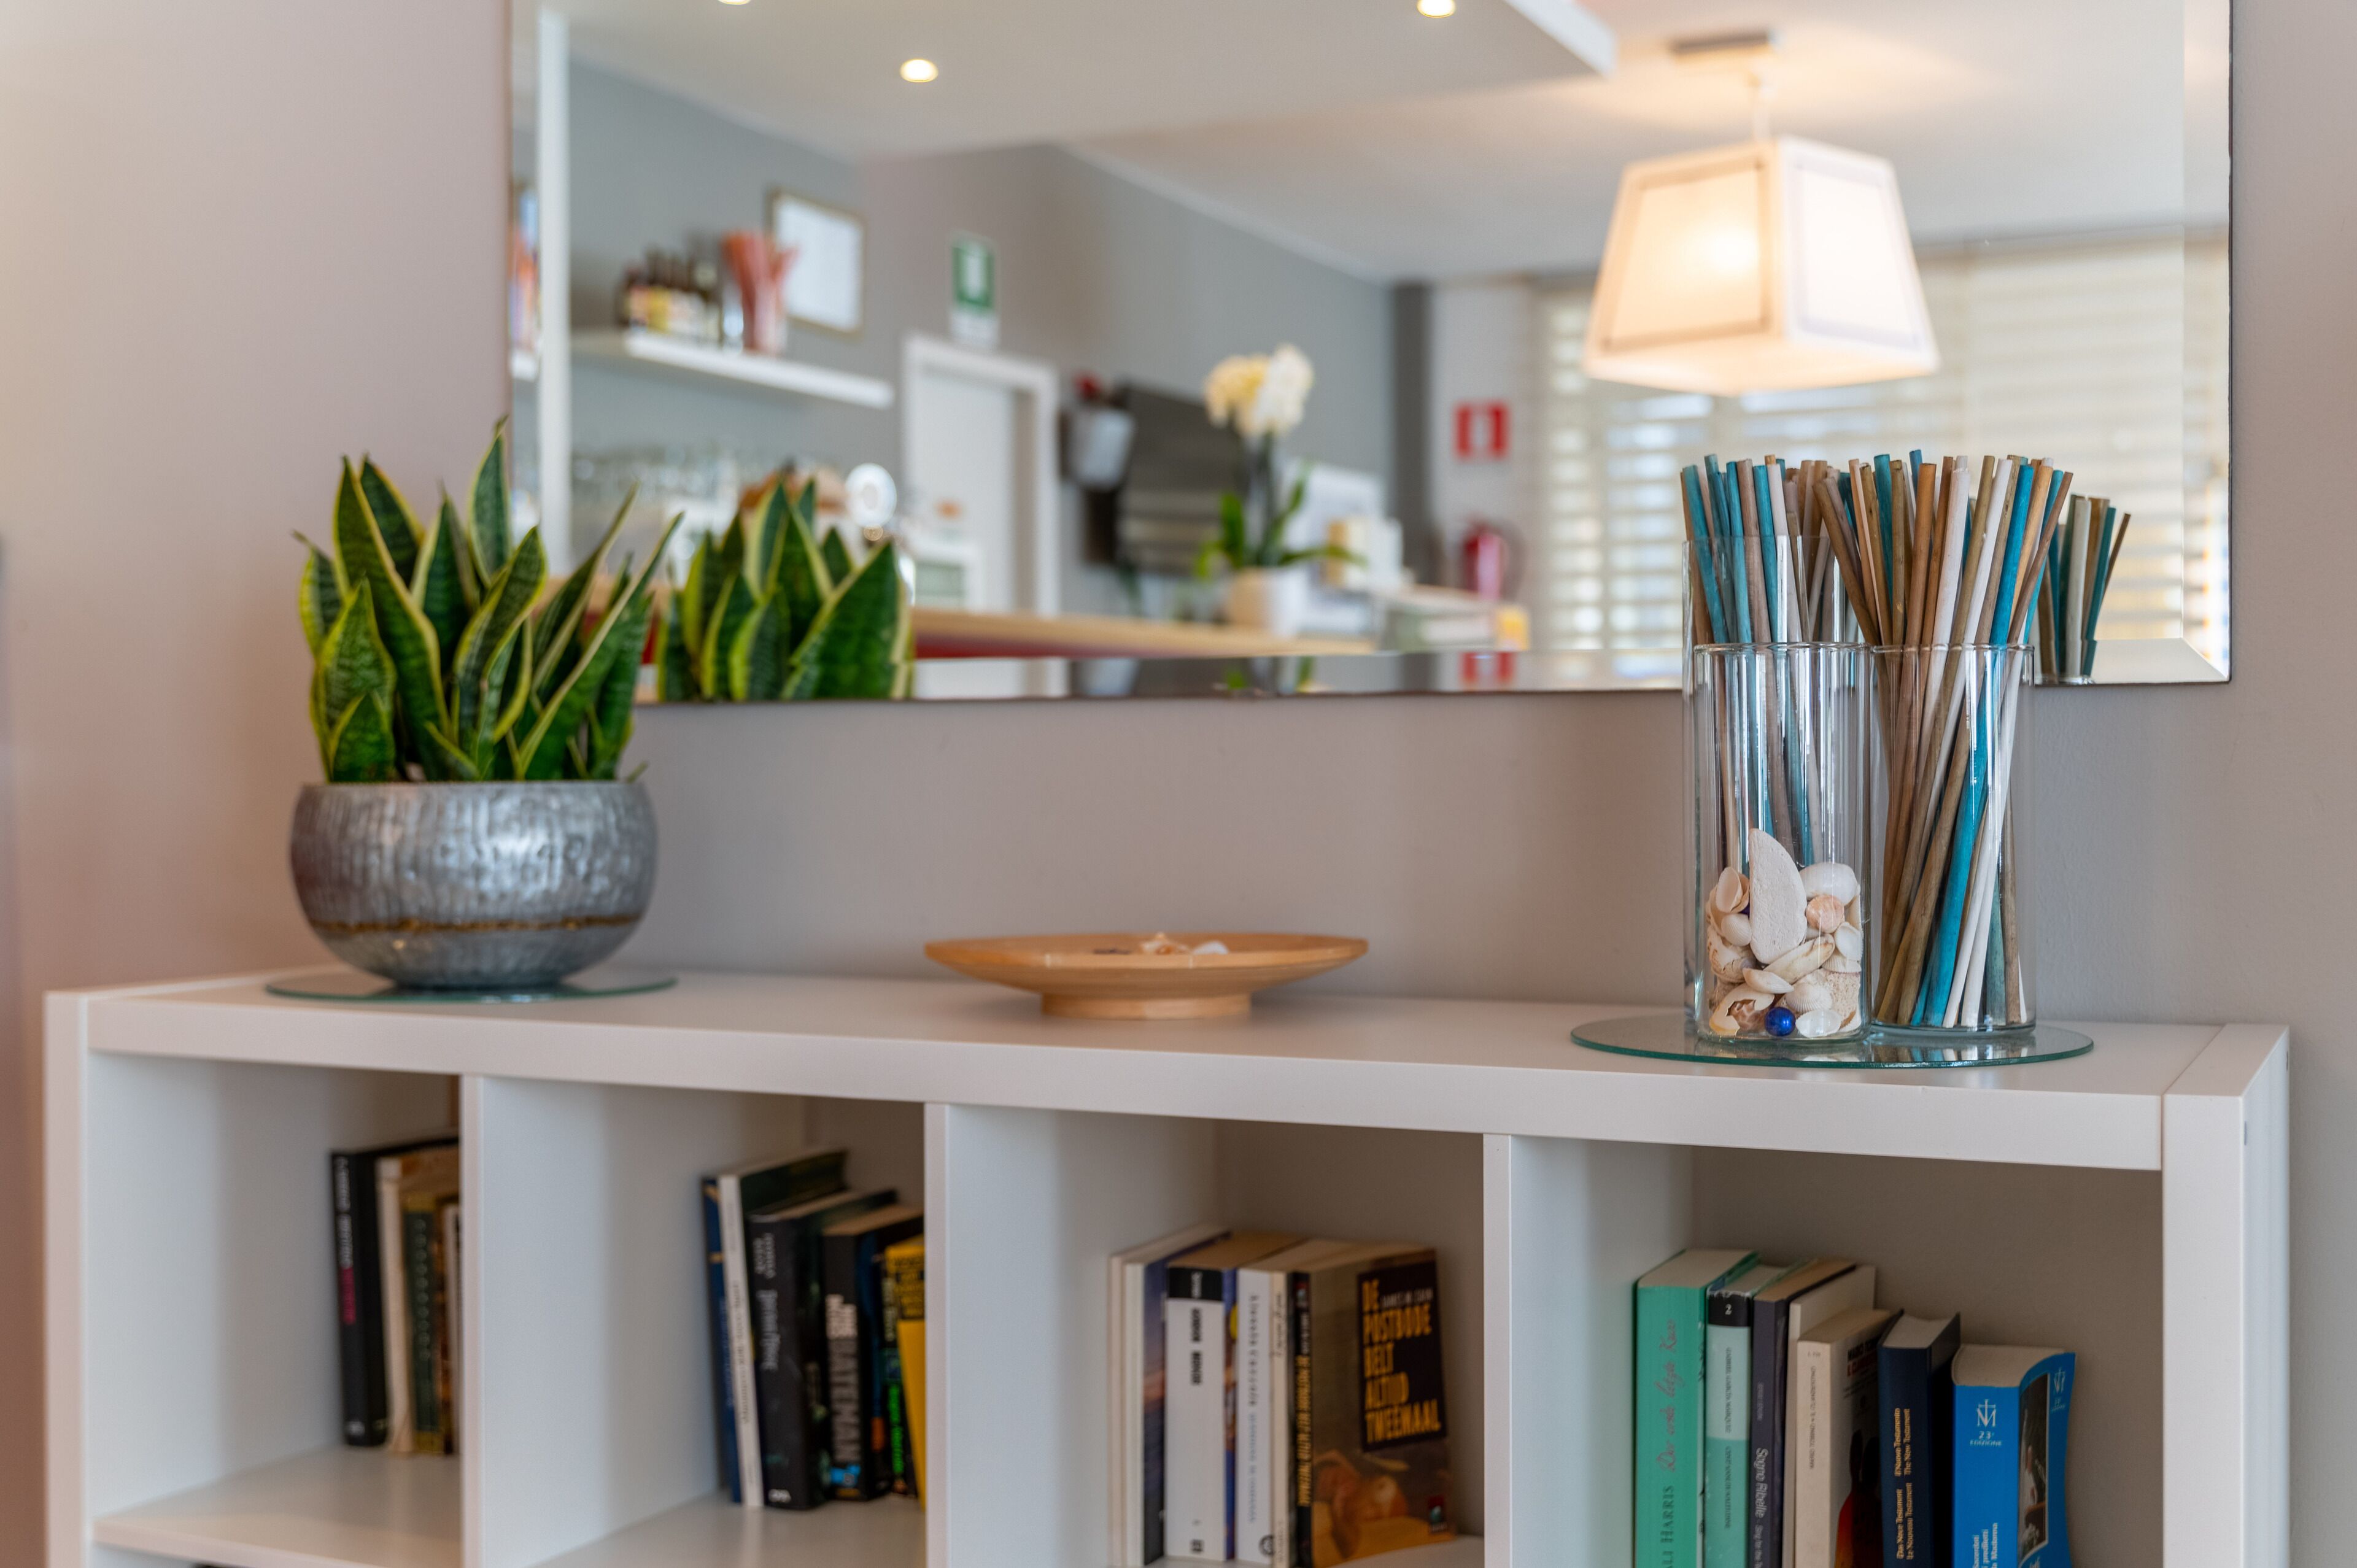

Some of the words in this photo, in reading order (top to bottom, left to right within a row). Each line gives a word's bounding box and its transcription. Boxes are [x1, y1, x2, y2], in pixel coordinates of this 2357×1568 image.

[1362, 1279, 1379, 1312] DE
[1725, 1303, 1732, 1315] 2
[1363, 1303, 1432, 1346] POSTBODE
[1364, 1340, 1395, 1379] BELT
[1365, 1398, 1441, 1444] TWEEMAAL
[1754, 1448, 1768, 1481] Sogno
[1660, 1485, 1674, 1543] HARRIS
[1755, 1482, 1768, 1518] Ribelle
